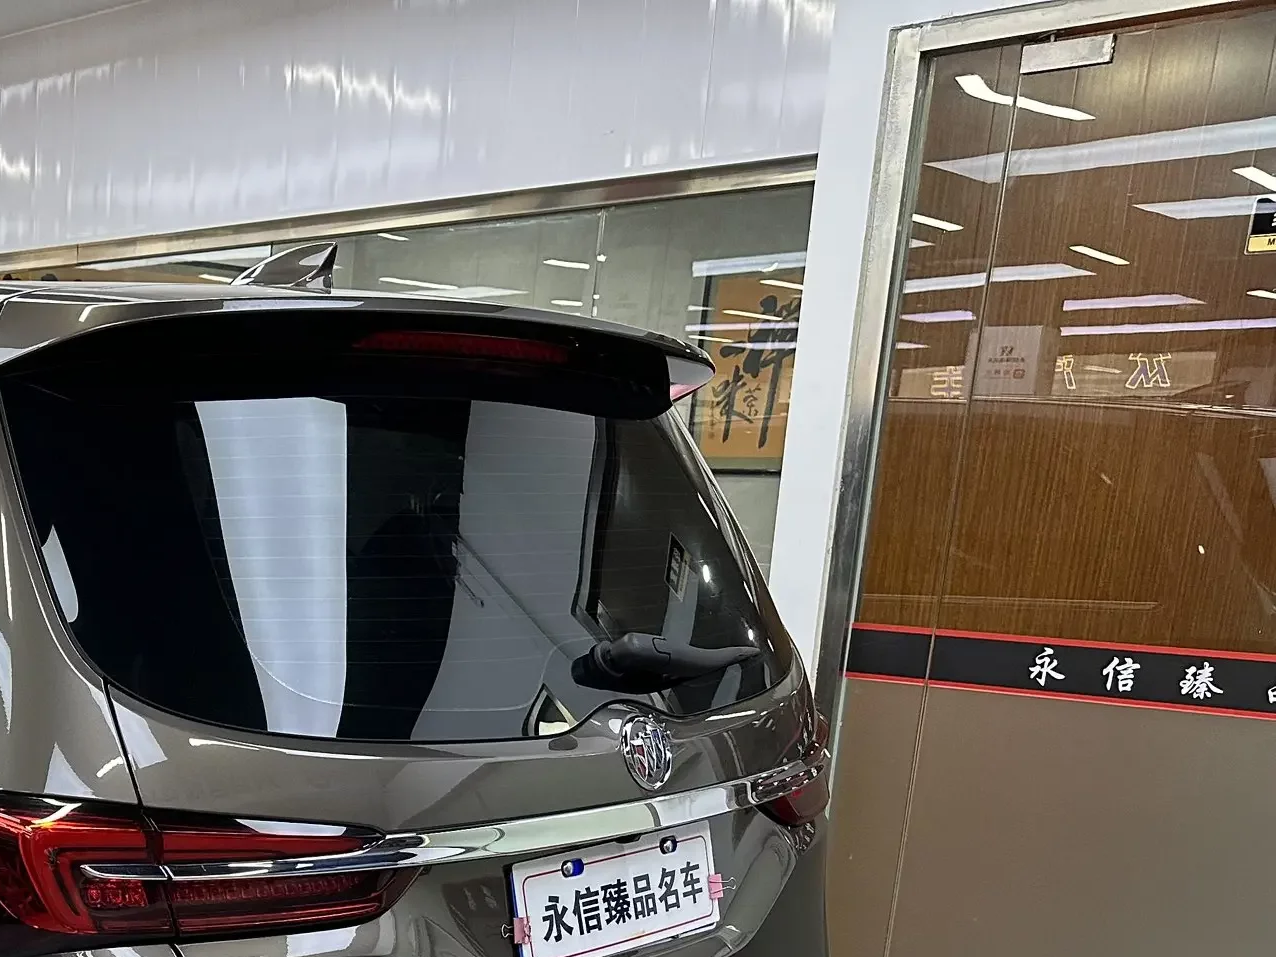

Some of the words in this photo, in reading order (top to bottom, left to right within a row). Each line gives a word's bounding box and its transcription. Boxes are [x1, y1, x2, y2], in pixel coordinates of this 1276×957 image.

[541, 861, 704, 943] 永信臻品名车
